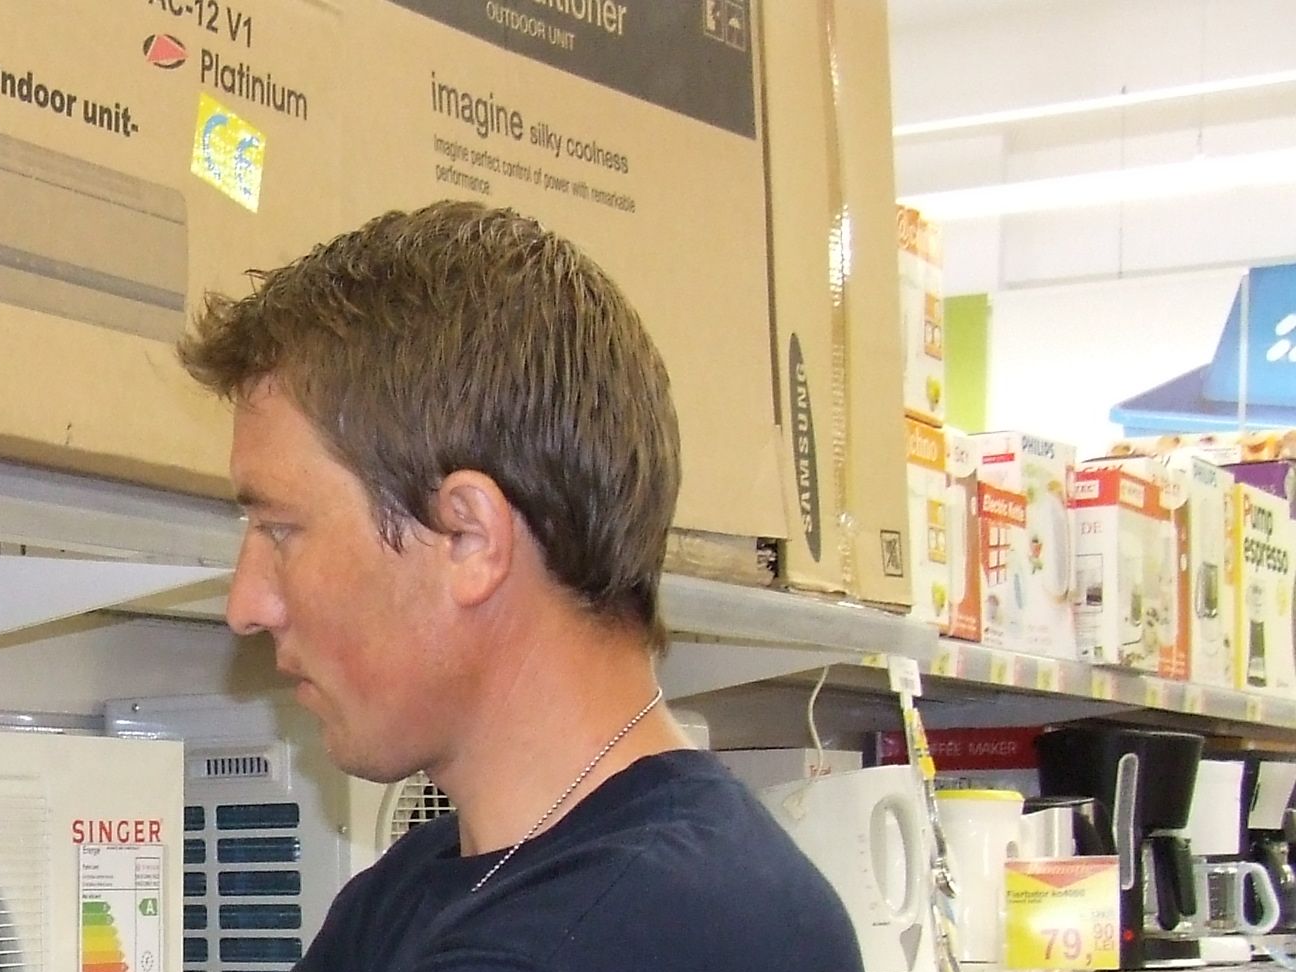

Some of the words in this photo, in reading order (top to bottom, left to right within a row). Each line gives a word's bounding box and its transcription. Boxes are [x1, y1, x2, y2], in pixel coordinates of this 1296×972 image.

[227, 7, 252, 47] V1
[486, 1, 546, 39] OUTDOOR
[548, 25, 575, 51] UNIT
[200, 49, 308, 120] Platinium
[431, 71, 523, 141] imagine
[529, 122, 562, 157] silky
[566, 136, 629, 174] coolness
[471, 148, 501, 173] perfect
[502, 157, 531, 181] control
[533, 165, 542, 181] of
[544, 170, 570, 193] power
[572, 176, 589, 197] with
[591, 183, 636, 213] remarkable
[795, 361, 812, 534] SAMSUNG
[1242, 490, 1273, 541] Pump
[1243, 536, 1289, 574] espresso
[969, 740, 1017, 757] MAKER
[72, 819, 161, 844] SINGER
[146, 900, 154, 914] A
